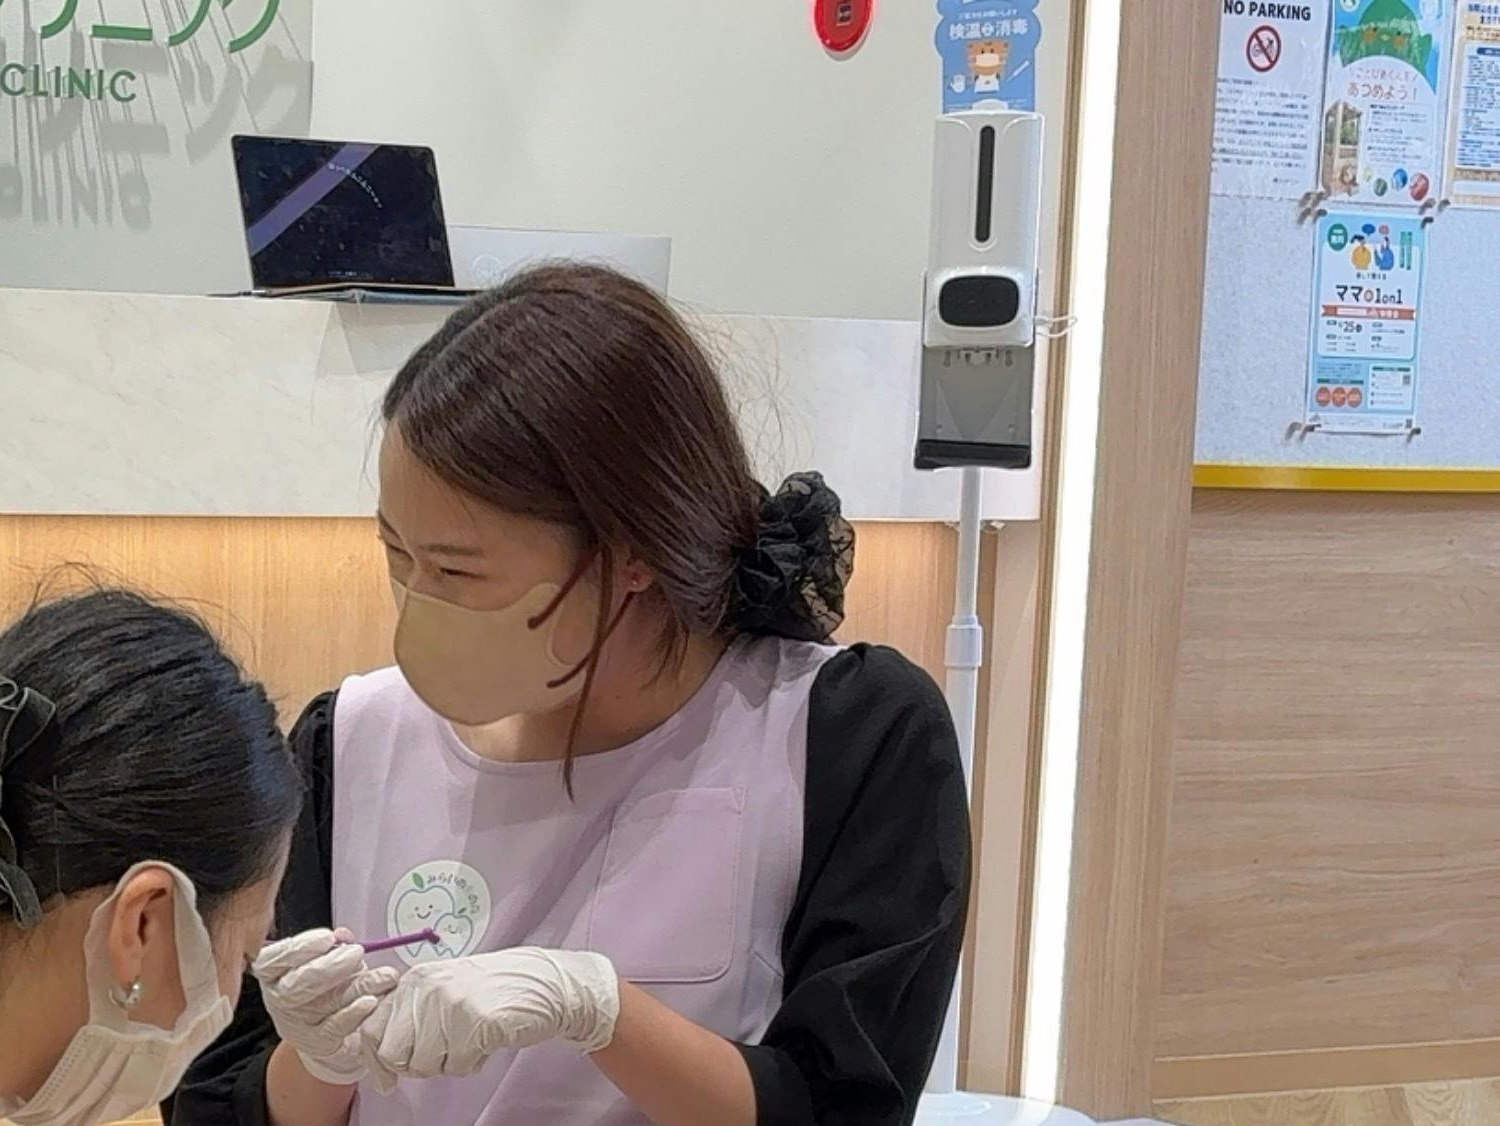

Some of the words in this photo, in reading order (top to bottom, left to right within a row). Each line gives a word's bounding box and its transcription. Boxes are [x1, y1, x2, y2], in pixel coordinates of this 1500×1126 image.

[1223, 0, 1246, 15] NO
[1250, 4, 1311, 21] PARKING
[0, 62, 136, 102] CLINIC
